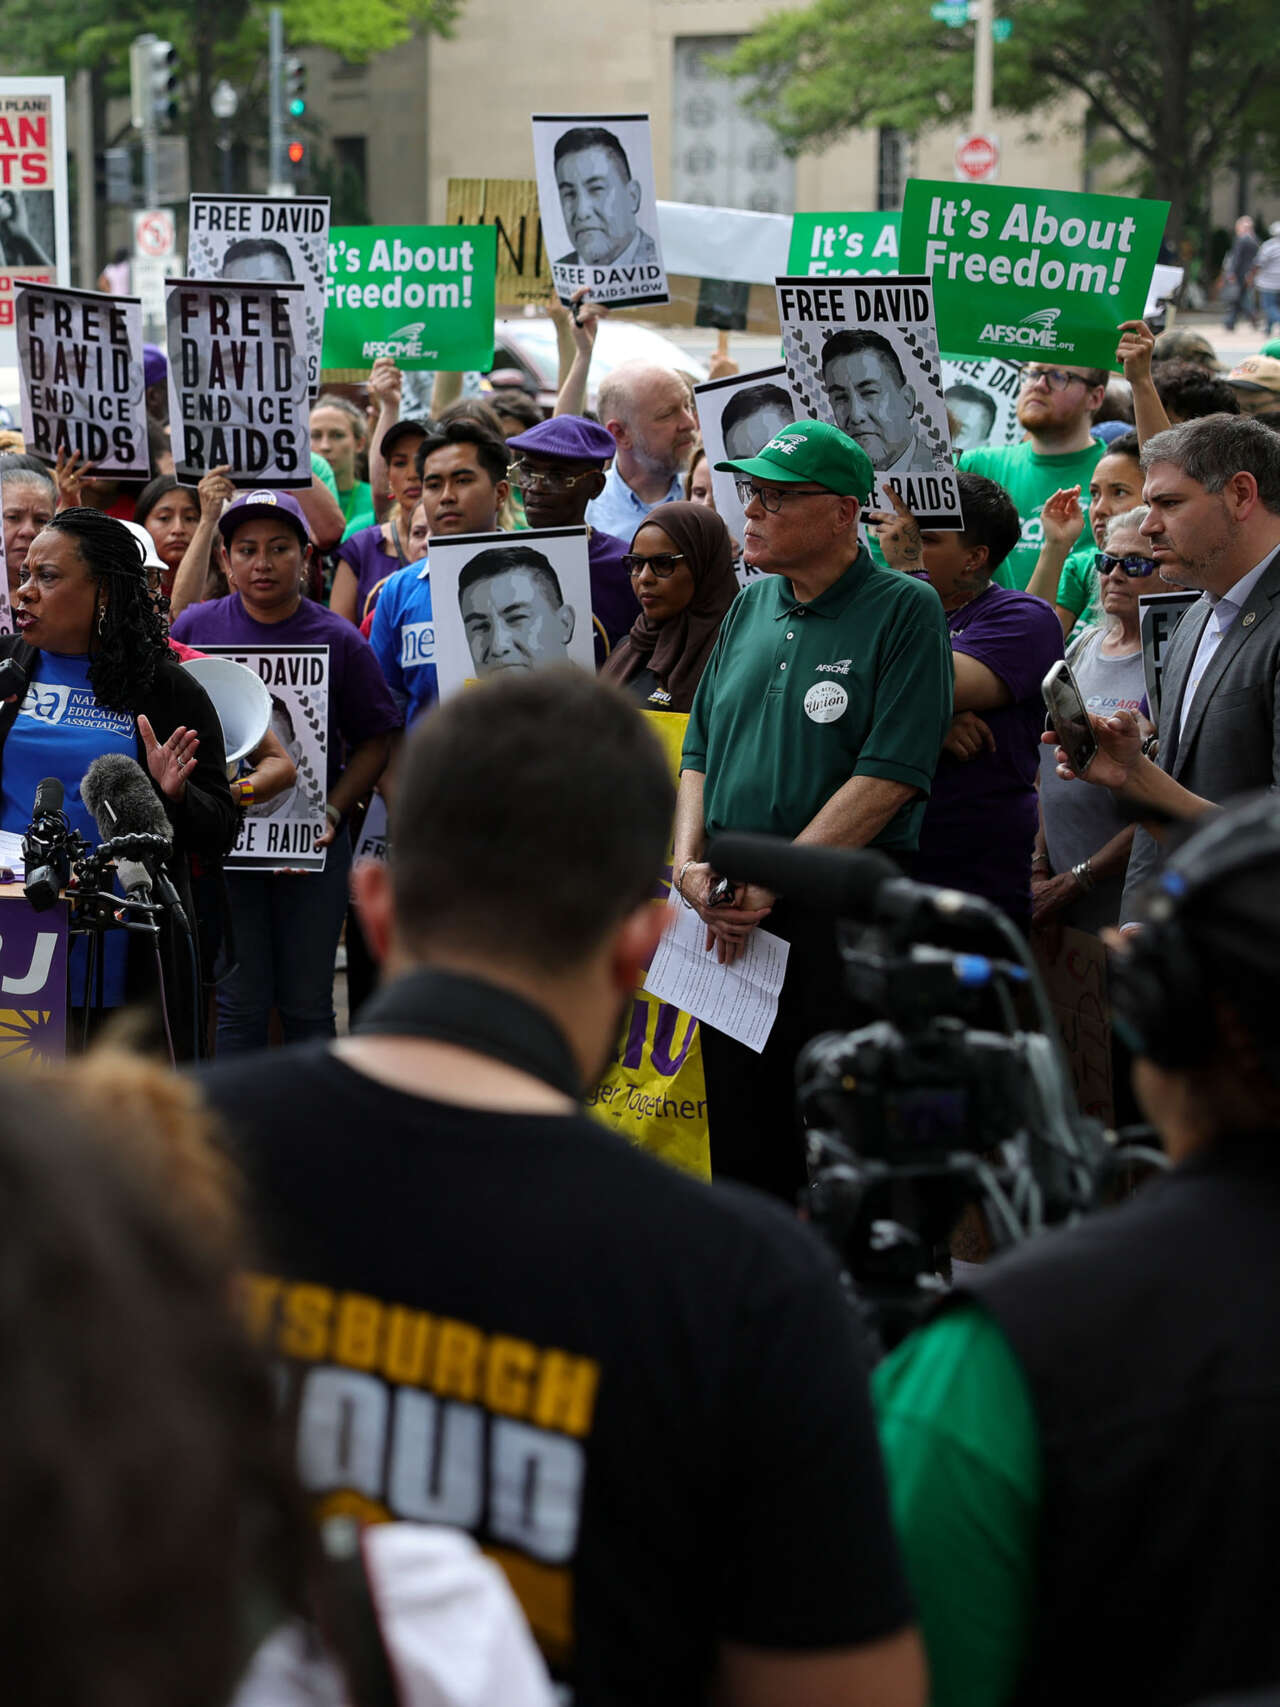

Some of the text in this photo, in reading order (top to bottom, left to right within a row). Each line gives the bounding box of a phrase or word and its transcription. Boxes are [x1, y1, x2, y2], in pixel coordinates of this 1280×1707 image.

[5, 101, 47, 112] PLAN!
[193, 204, 325, 234] FREE DAVID
[928, 197, 1137, 253] It's About
[369, 239, 474, 273] About
[811, 224, 865, 258] It's
[553, 265, 661, 286] FREE DAVID
[924, 239, 1127, 296] Freedom!
[323, 275, 473, 309] Freedom!
[588, 283, 663, 299] RAIDS NOW
[780, 289, 929, 323] FREE DAVID
[28, 295, 128, 347] FREE
[180, 291, 290, 340] FREE
[29, 335, 131, 394] DAVID
[181, 336, 292, 393] DAVID
[31, 383, 131, 424] END ICE
[182, 392, 293, 425] END ICE
[32, 411, 136, 465] RAIDS
[183, 424, 298, 473] RAIDS
[890, 475, 956, 511] RAIDS
[404, 627, 435, 661] ne
[258, 657, 325, 686] DAVID
[815, 663, 850, 675] AFSCME
[67, 706, 136, 726] EDUCATION
[806, 695, 845, 714] Union
[1101, 698, 1141, 710] USAID
[63, 717, 132, 731] ASSOCIATION
[233, 823, 324, 854] CE RAIDS
[626, 1083, 708, 1121] Together
